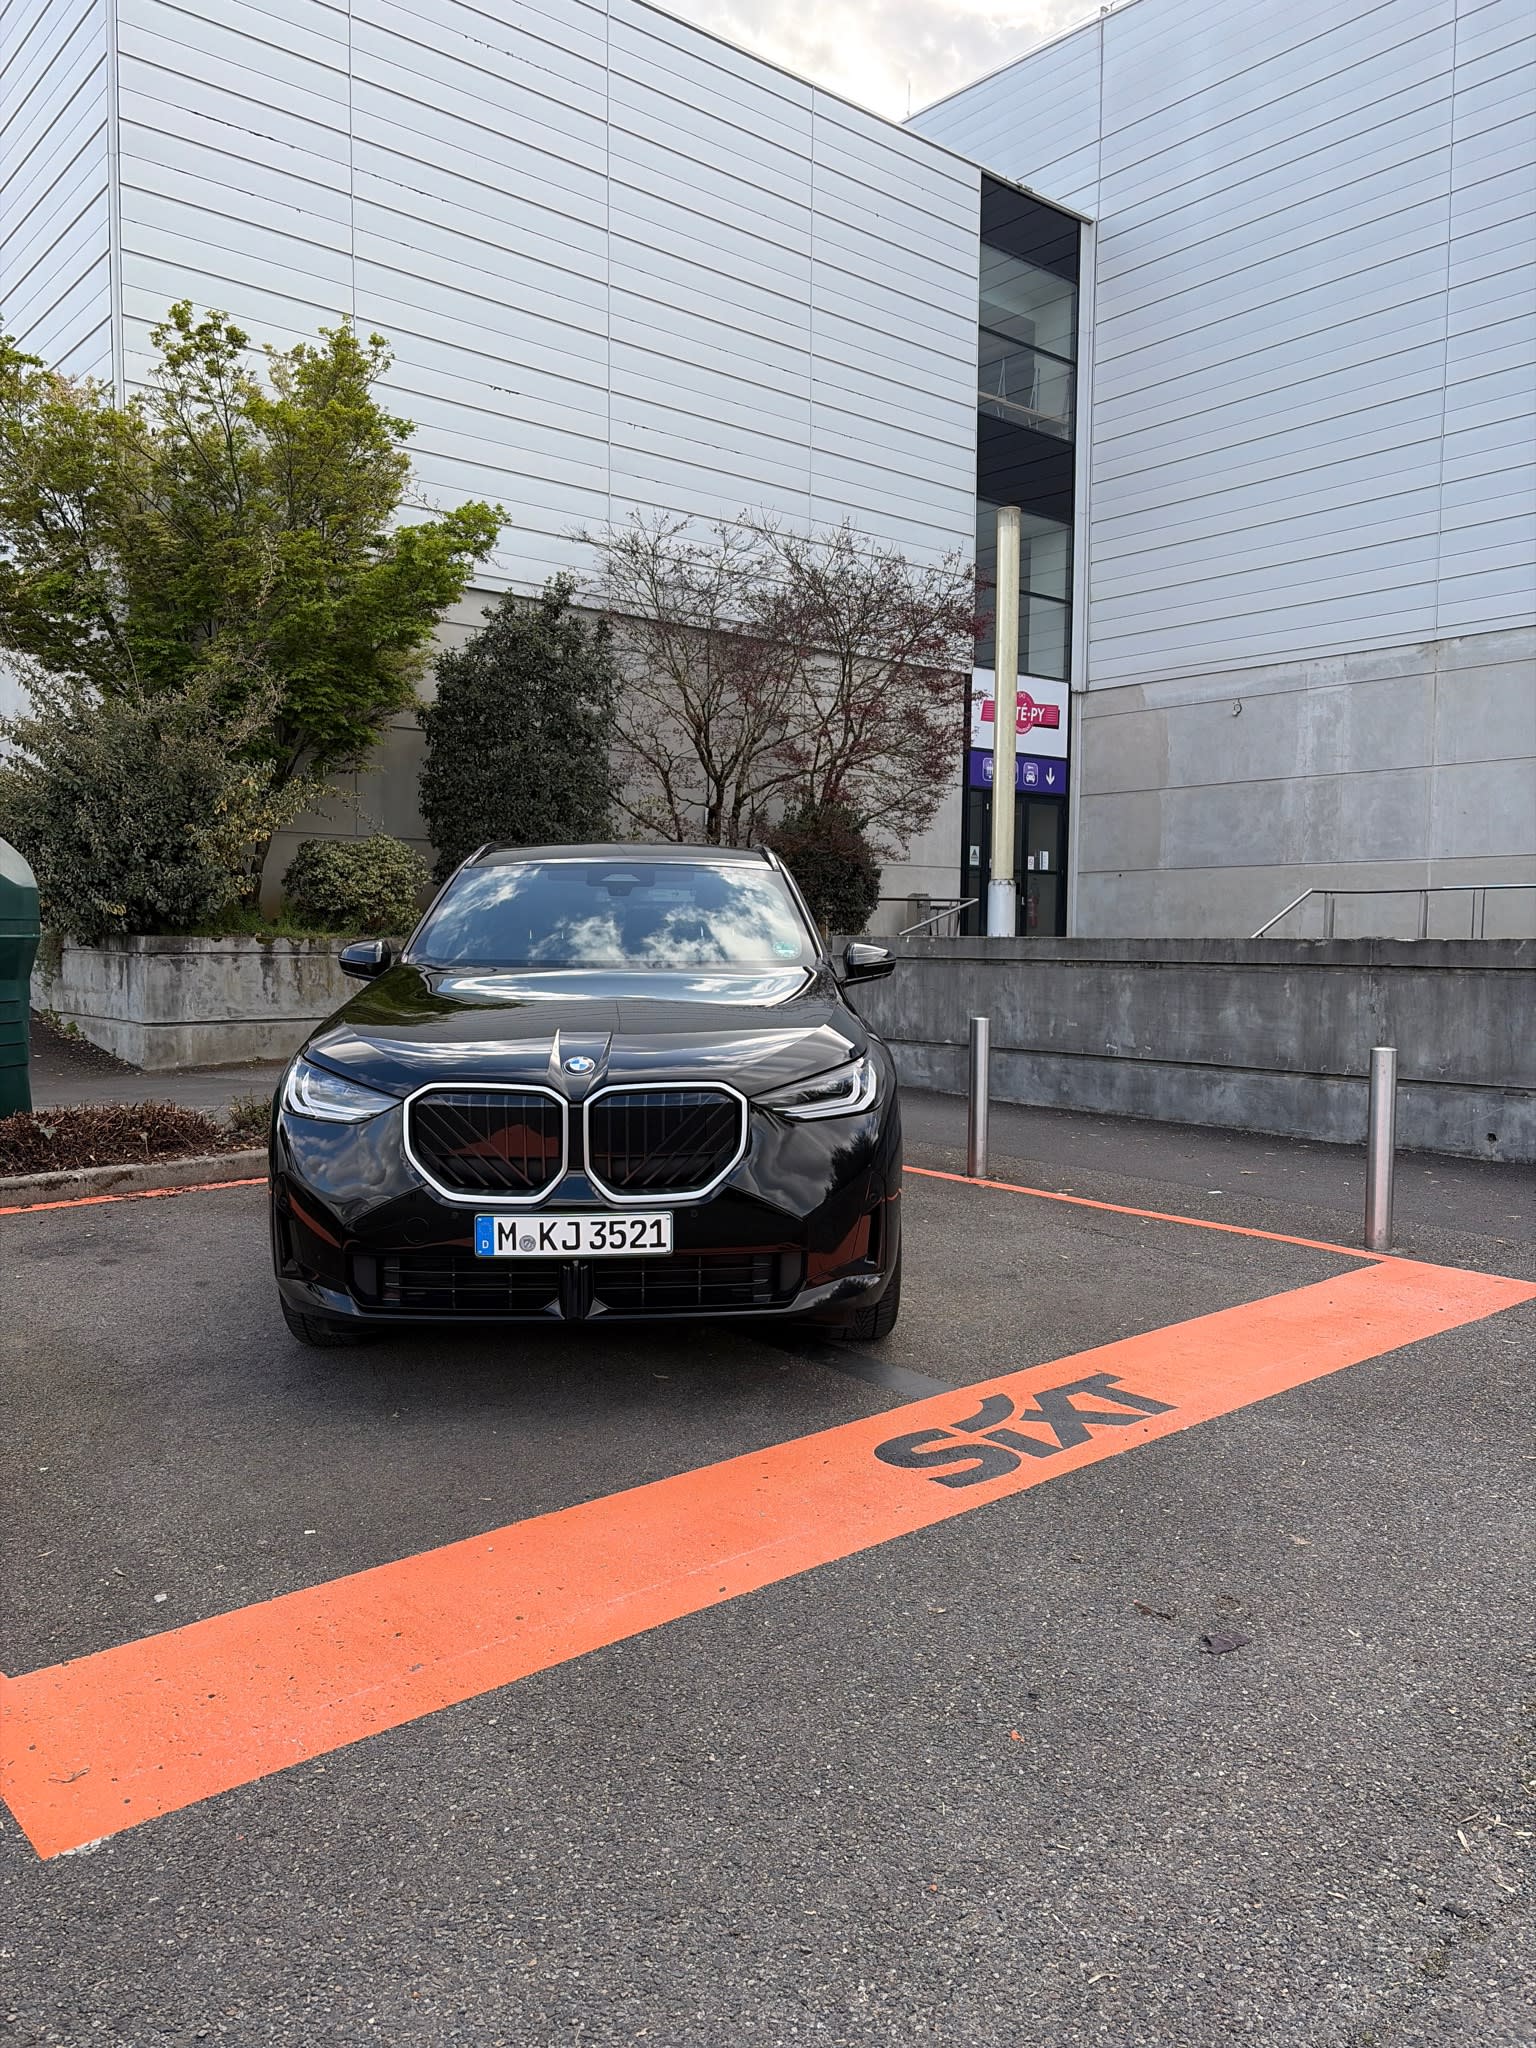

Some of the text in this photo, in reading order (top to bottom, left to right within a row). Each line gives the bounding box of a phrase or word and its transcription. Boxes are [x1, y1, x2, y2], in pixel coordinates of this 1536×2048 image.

[481, 1240, 489, 1249] D
[497, 1219, 667, 1251] M KJ 3521
